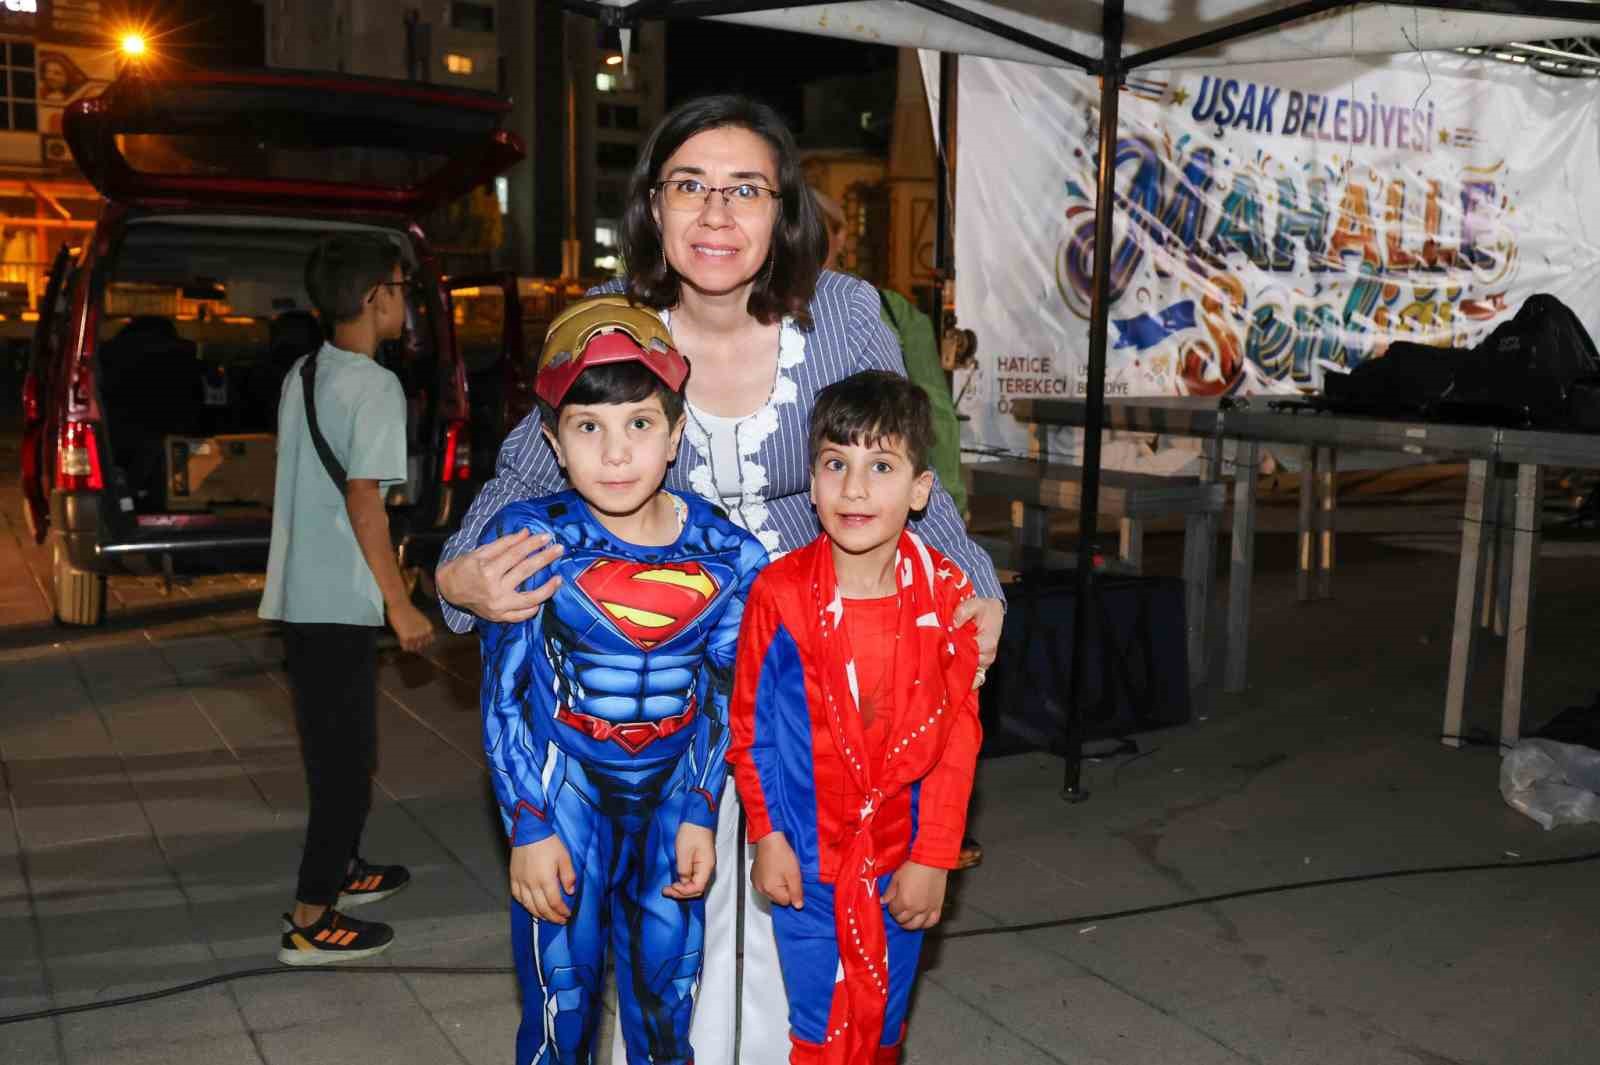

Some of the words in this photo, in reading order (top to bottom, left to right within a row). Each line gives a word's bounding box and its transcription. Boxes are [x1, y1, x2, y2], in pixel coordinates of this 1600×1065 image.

[1191, 74, 1281, 138] UŞAK
[1281, 89, 1435, 153] BELEDİYESİ
[1058, 136, 1512, 296] MAHALLE
[997, 354, 1051, 373] HATİCE
[997, 375, 1068, 394] TEREKECİ
